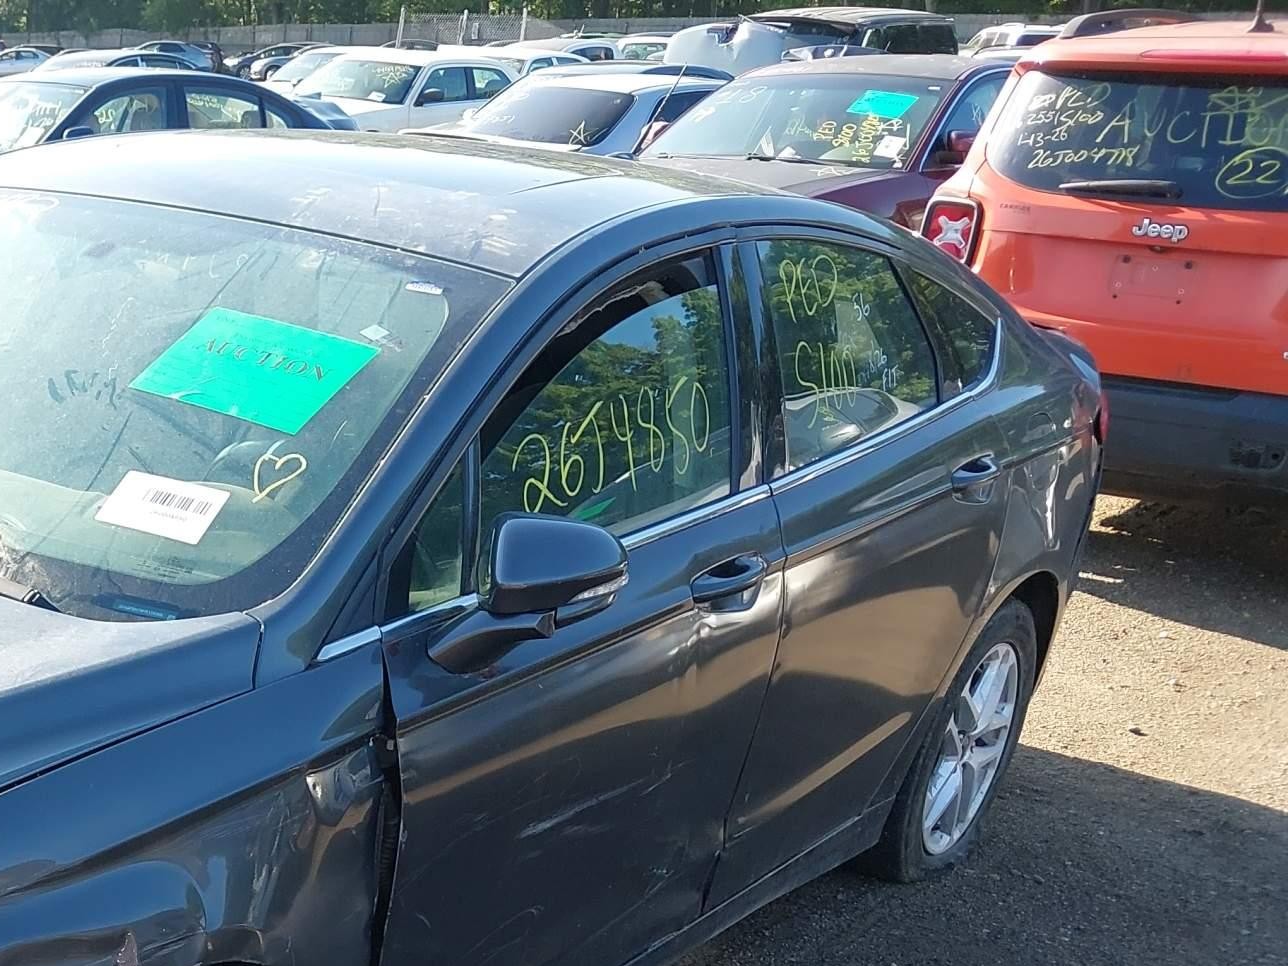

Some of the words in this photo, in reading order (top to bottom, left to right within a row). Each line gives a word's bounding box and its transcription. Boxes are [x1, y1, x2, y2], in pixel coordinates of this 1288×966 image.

[1226, 158, 1281, 184] 22
[1131, 217, 1189, 243] Jeep
[197, 338, 332, 382] AUCTION
[513, 376, 710, 513] 26J4850
